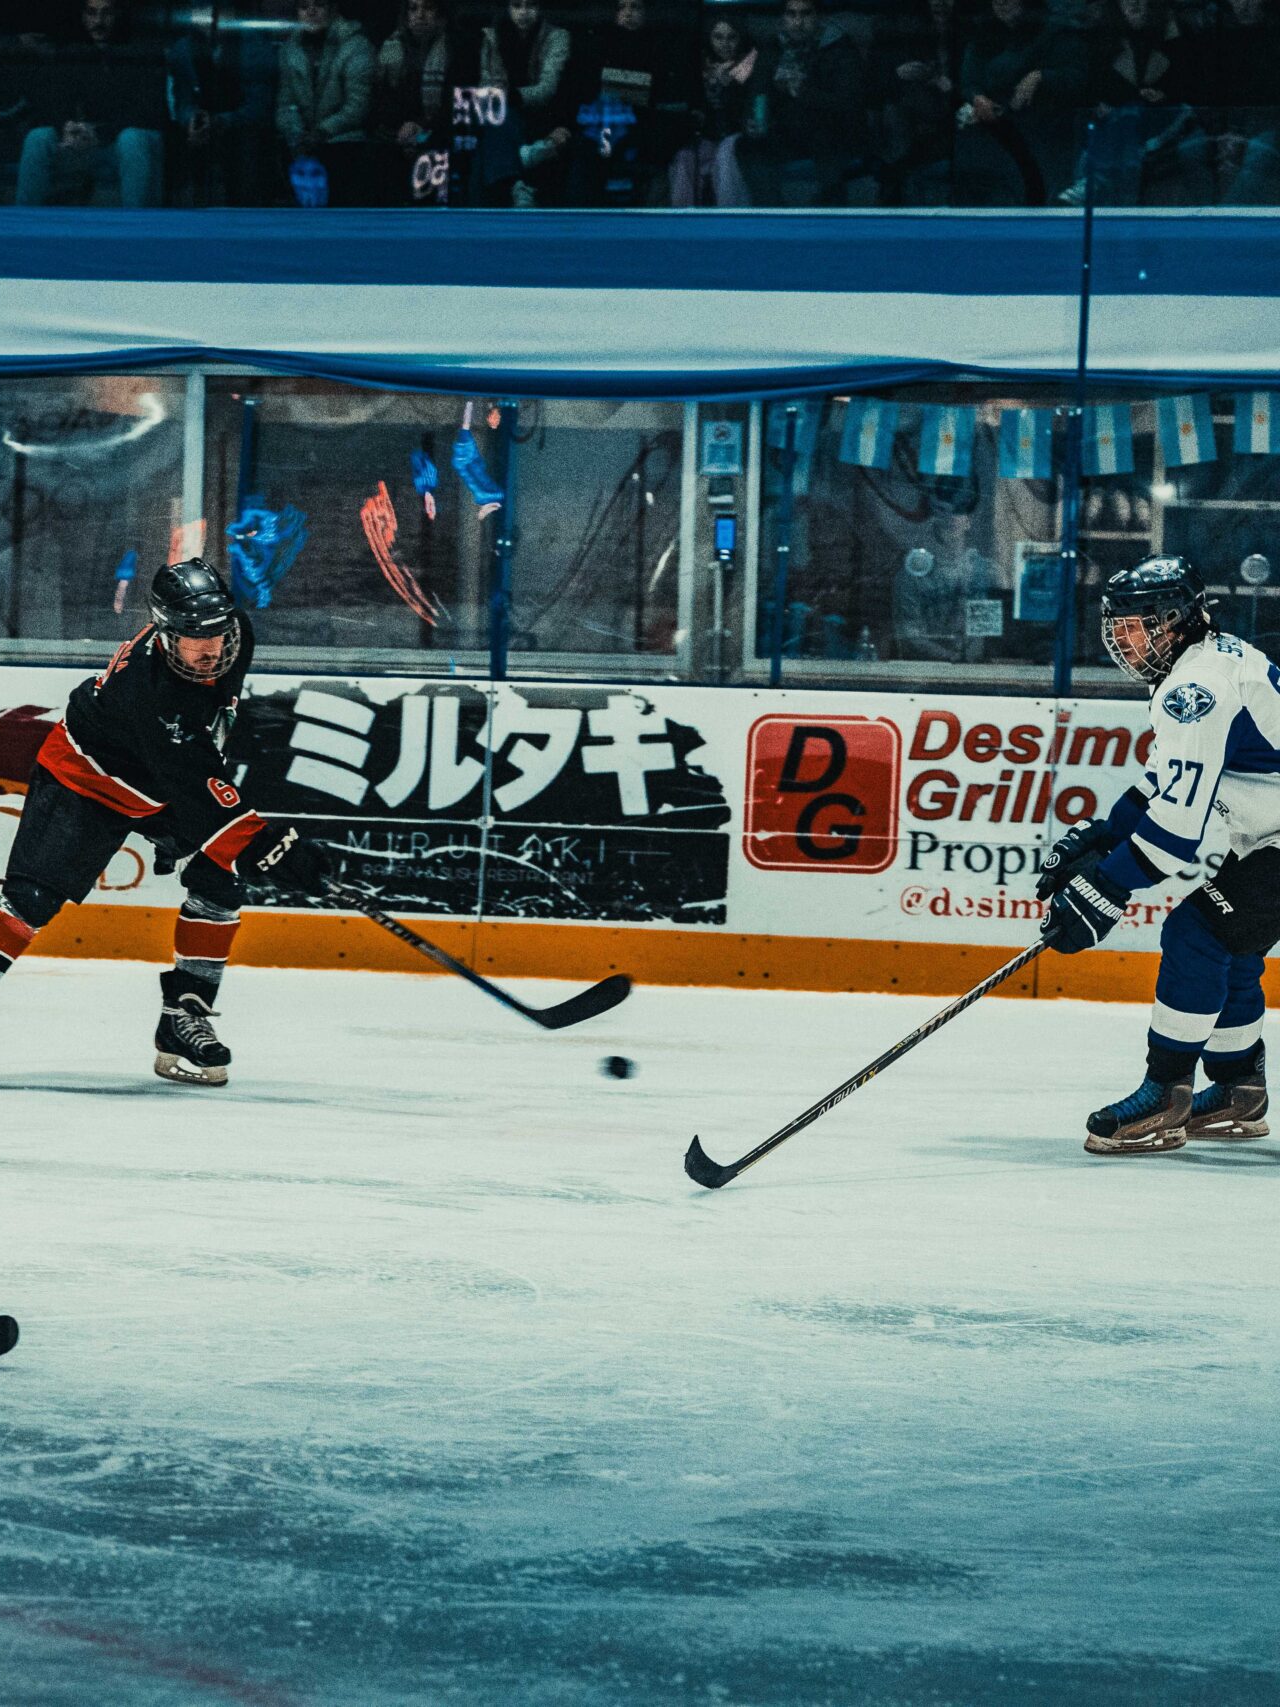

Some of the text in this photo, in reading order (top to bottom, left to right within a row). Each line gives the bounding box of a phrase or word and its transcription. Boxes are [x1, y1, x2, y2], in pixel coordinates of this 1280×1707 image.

[285, 689, 676, 816] ミルタキ
[907, 709, 1157, 767] Desim
[207, 777, 241, 808] 6
[905, 768, 1098, 826] Grillo
[1160, 758, 1204, 807] 27
[440, 866, 484, 881] SUSH
[1069, 873, 1124, 921] WARRIOR
